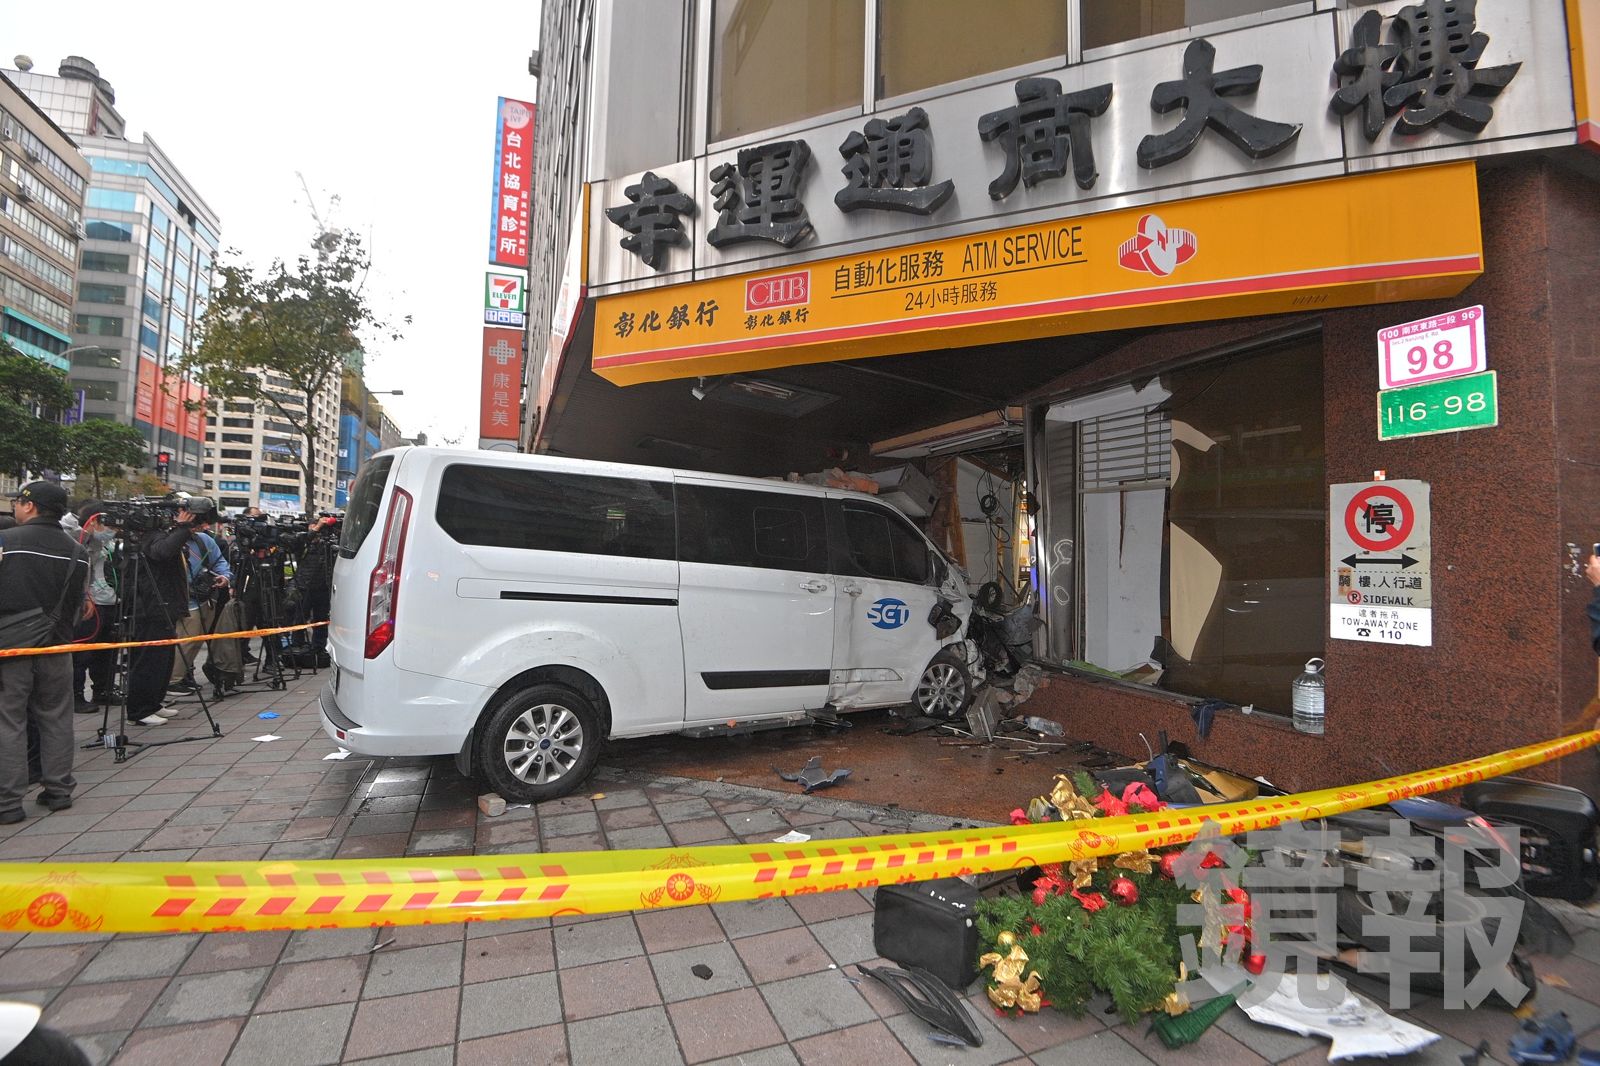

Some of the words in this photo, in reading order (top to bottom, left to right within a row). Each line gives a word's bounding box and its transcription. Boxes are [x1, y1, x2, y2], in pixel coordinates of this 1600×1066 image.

[604, 0, 1523, 270] 幸運通商大樓
[834, 250, 944, 292] 自動化服務
[962, 240, 998, 273] ATM
[1003, 226, 1083, 267] SERVICE
[750, 277, 806, 306] CHB
[905, 281, 998, 312] 24小時服務
[613, 300, 719, 338] 彰化銀行
[744, 307, 809, 330] 彰化銀行
[1381, 329, 1399, 340] 100
[1402, 315, 1456, 334] 南京東路二段
[1461, 310, 1475, 321] 96
[1407, 340, 1454, 375] 98
[491, 373, 510, 426] 康是美
[1388, 392, 1486, 424] 116-98
[1363, 504, 1395, 534] 停
[1363, 595, 1414, 606] SIDEWALK
[1342, 618, 1389, 628] TOW-AWAY
[1393, 621, 1418, 631] ZONE
[1380, 630, 1402, 640] 110
